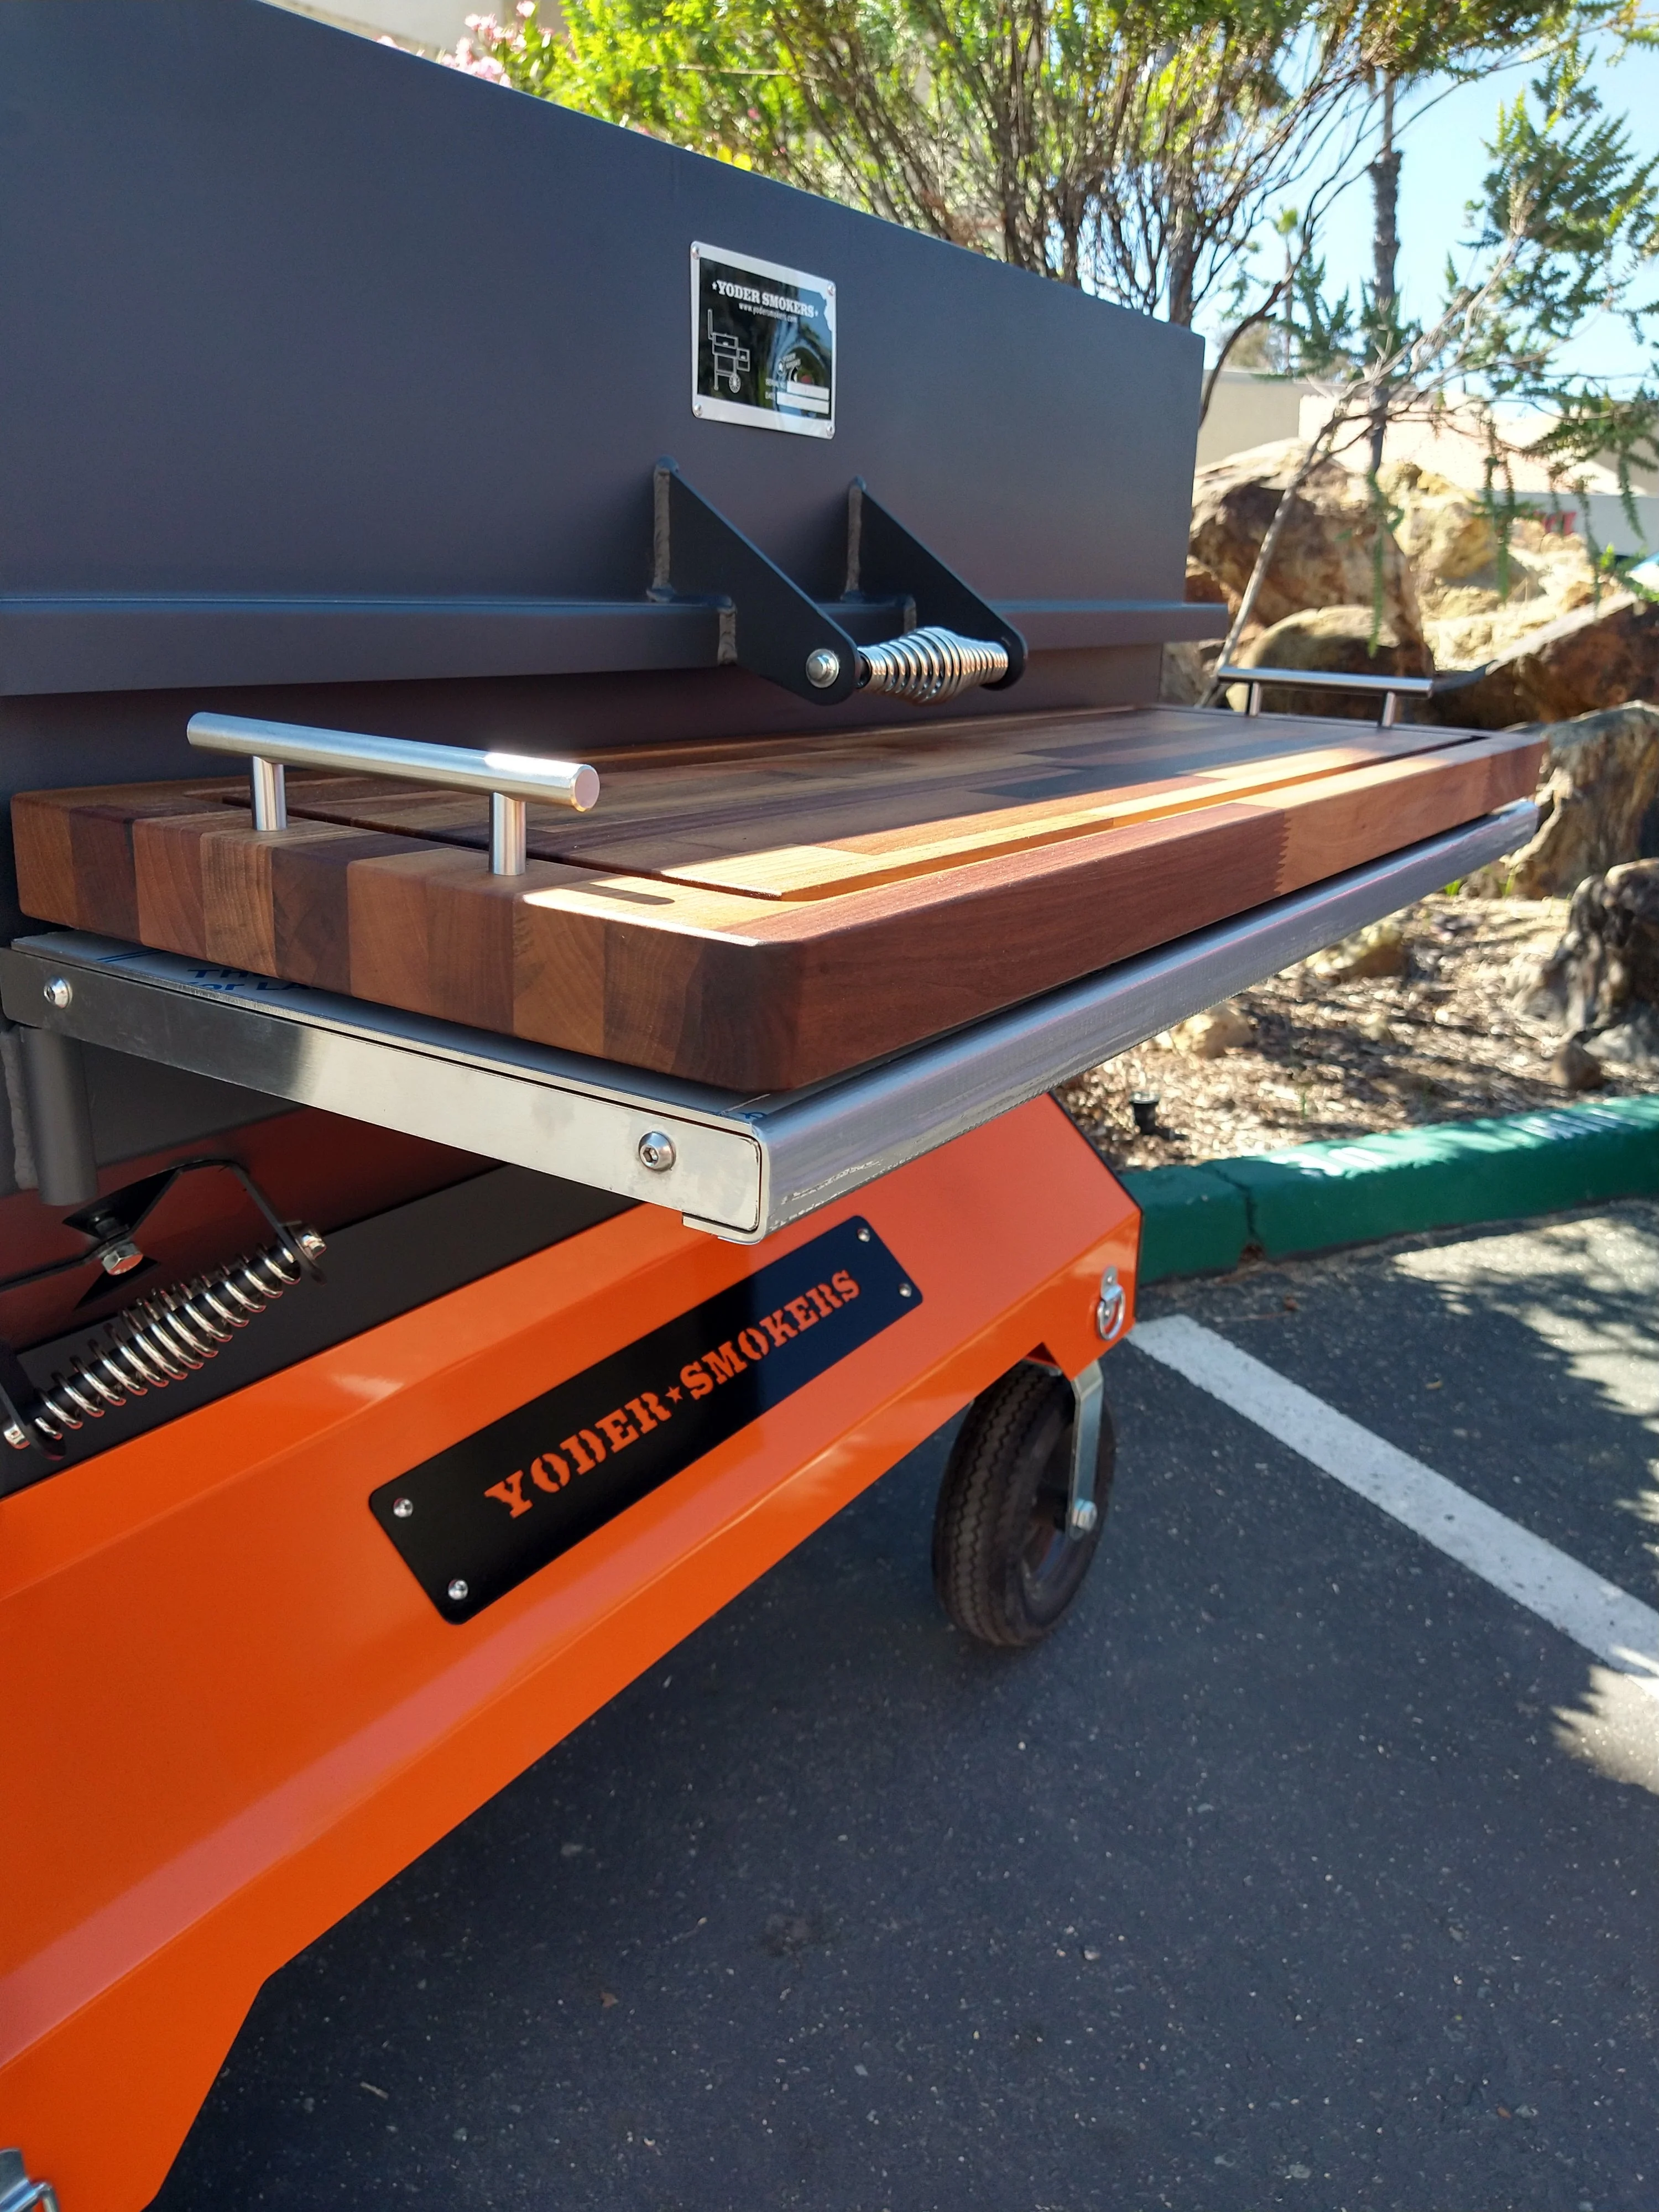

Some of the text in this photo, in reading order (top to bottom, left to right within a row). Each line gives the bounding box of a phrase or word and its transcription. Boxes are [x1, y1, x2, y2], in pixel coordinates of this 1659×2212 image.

[716, 279, 815, 319] YODER SMOKERS
[187, 969, 267, 978] Th
[188, 982, 244, 990] or
[484, 1270, 860, 1519] YODER SMOKERS
